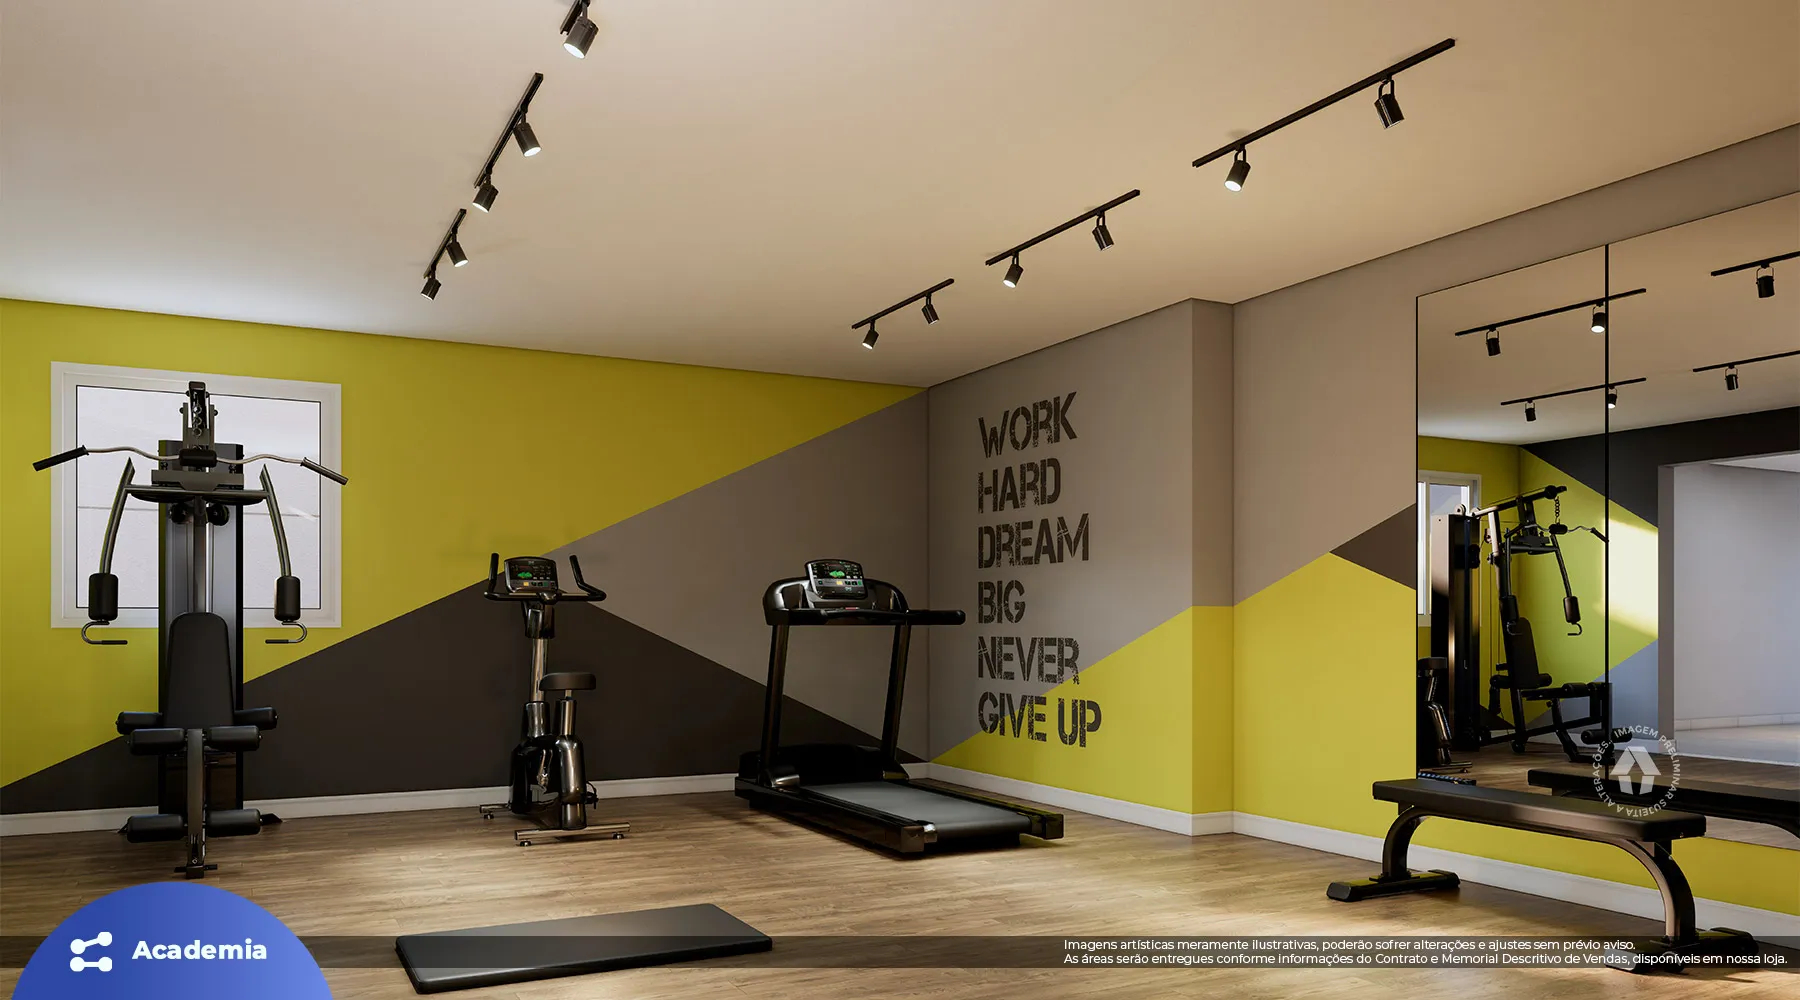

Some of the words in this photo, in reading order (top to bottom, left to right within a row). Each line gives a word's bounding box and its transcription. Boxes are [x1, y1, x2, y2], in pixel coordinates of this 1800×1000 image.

[978, 391, 1078, 459] WORK
[977, 457, 1062, 514] HARD
[977, 513, 1090, 569] DREAM
[978, 579, 1026, 624] BIG
[978, 636, 1080, 685] NEVER
[978, 692, 1047, 743] GIVE
[1057, 697, 1102, 748] UP
